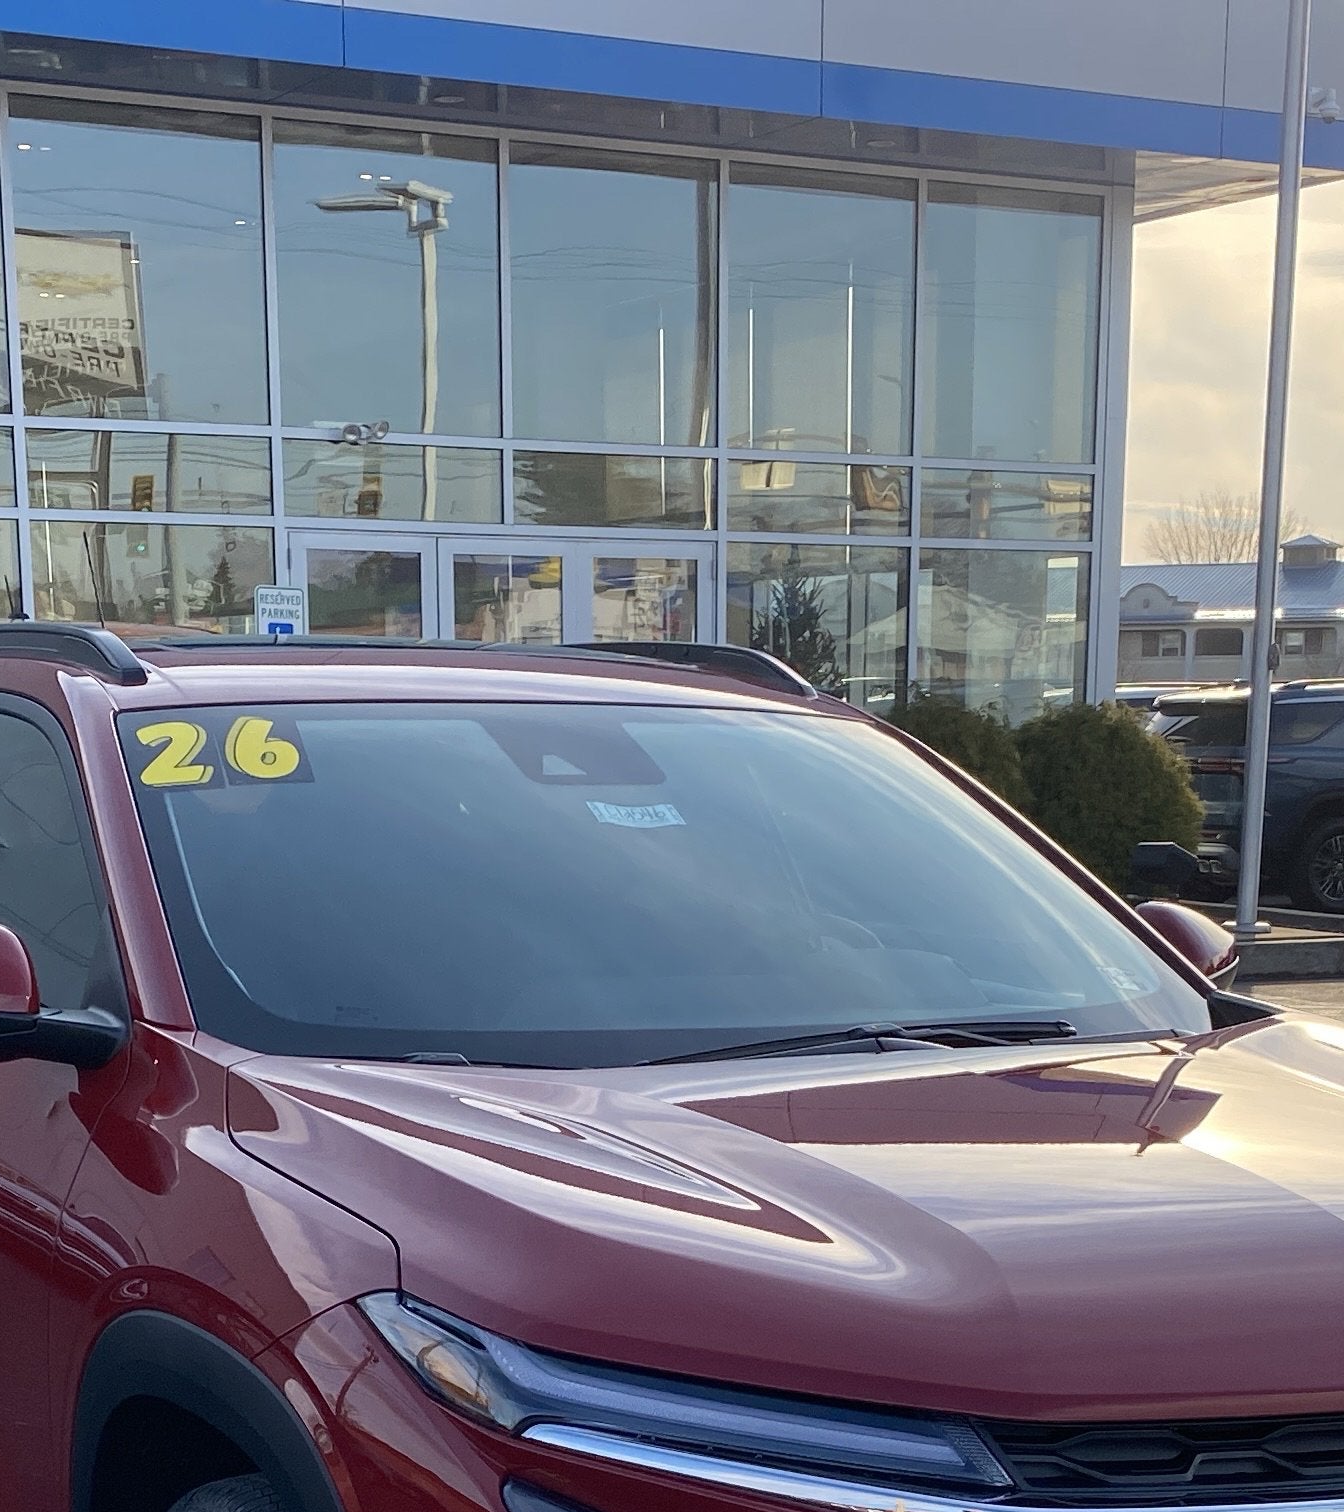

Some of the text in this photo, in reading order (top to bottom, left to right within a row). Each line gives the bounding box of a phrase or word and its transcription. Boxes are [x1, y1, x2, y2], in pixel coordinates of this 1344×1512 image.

[259, 593, 301, 606] RESERVED
[261, 607, 300, 619] PARKING
[135, 715, 300, 787] 26
